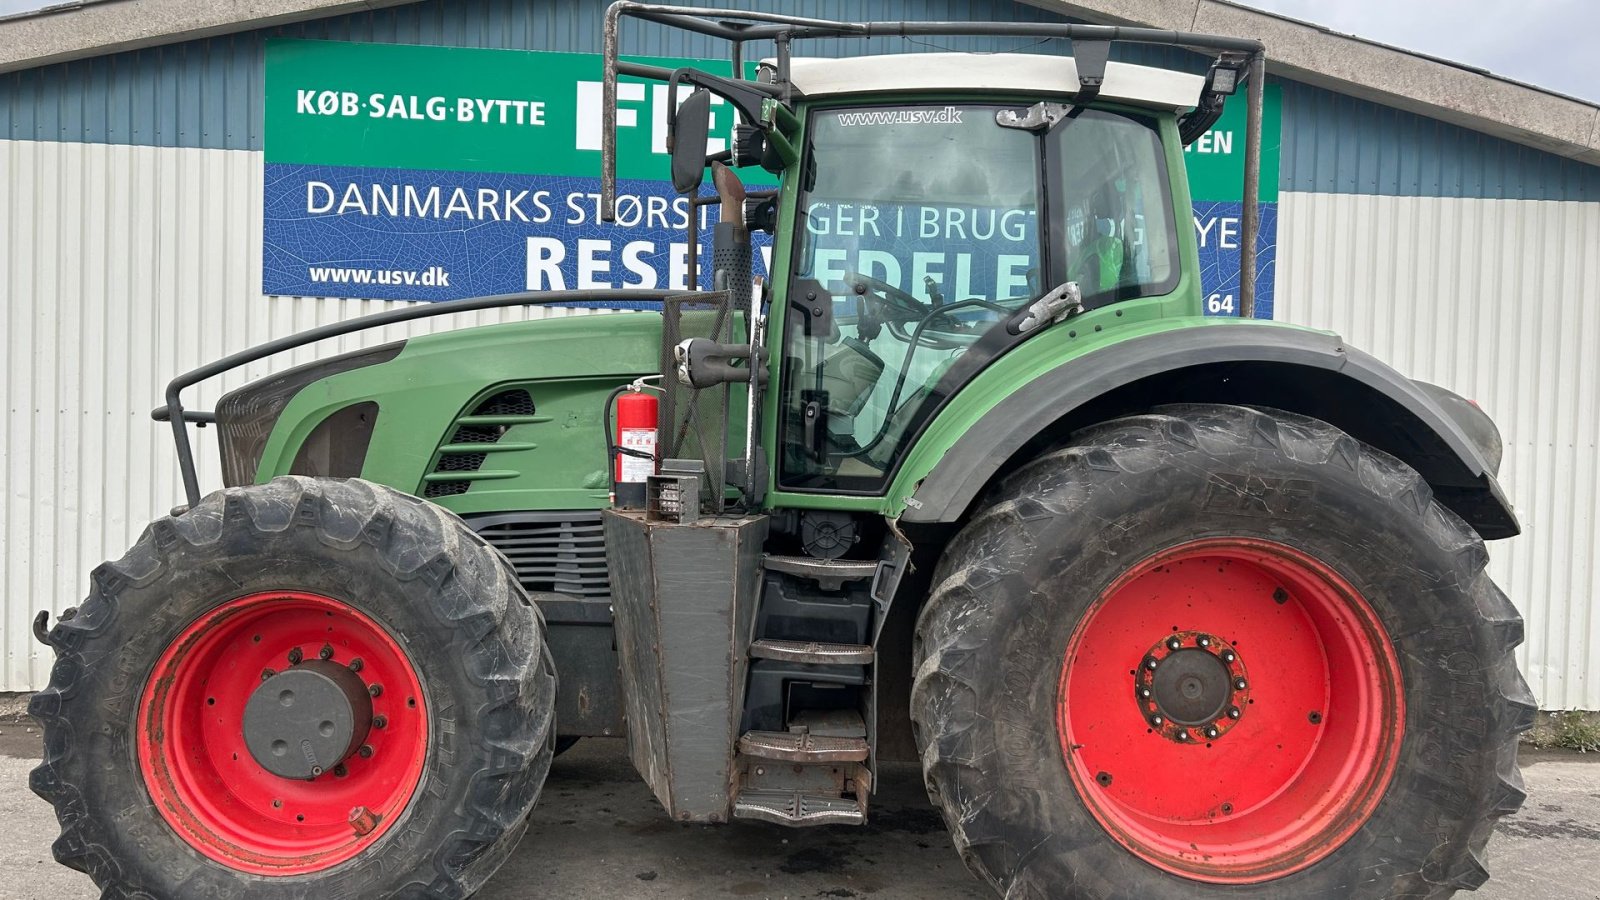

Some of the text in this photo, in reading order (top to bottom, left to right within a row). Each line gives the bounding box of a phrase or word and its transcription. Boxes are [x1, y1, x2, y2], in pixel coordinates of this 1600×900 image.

[837, 106, 963, 127] www.usv.dk
[1185, 130, 1233, 154] EN
[306, 181, 552, 223] DANMARKS
[806, 202, 872, 237] GER
[919, 206, 1036, 242] BRUG
[1193, 217, 1239, 249] YE
[308, 266, 450, 288] www.usv.dk
[1207, 294, 1234, 314] 64
